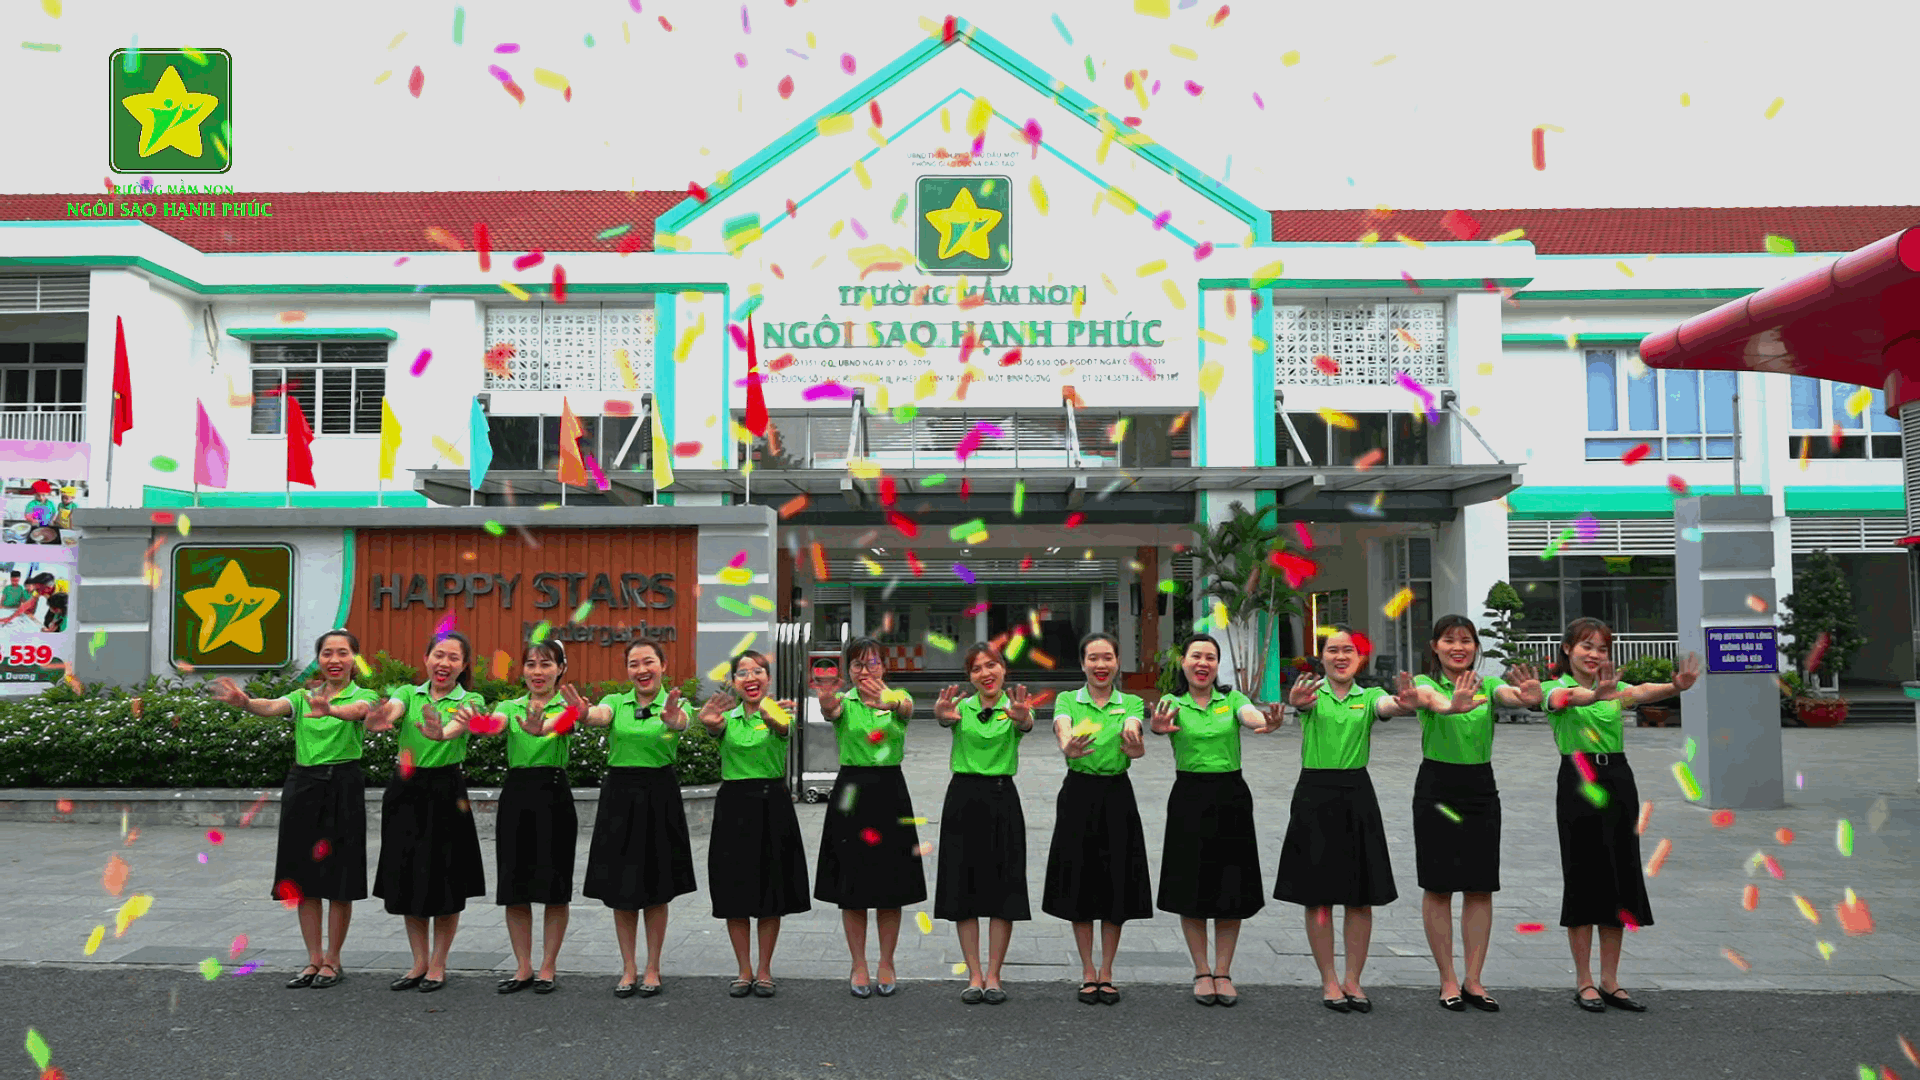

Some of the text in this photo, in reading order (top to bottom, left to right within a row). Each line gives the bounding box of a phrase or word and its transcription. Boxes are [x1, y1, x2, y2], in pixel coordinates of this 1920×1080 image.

[1028, 284, 1087, 305] NON
[763, 311, 1165, 356] NGÔI SAO HẠNH PHÚC
[372, 571, 678, 610] HAPPY STARS
[523, 619, 678, 647] Kndergarten
[9, 644, 53, 666] 539
